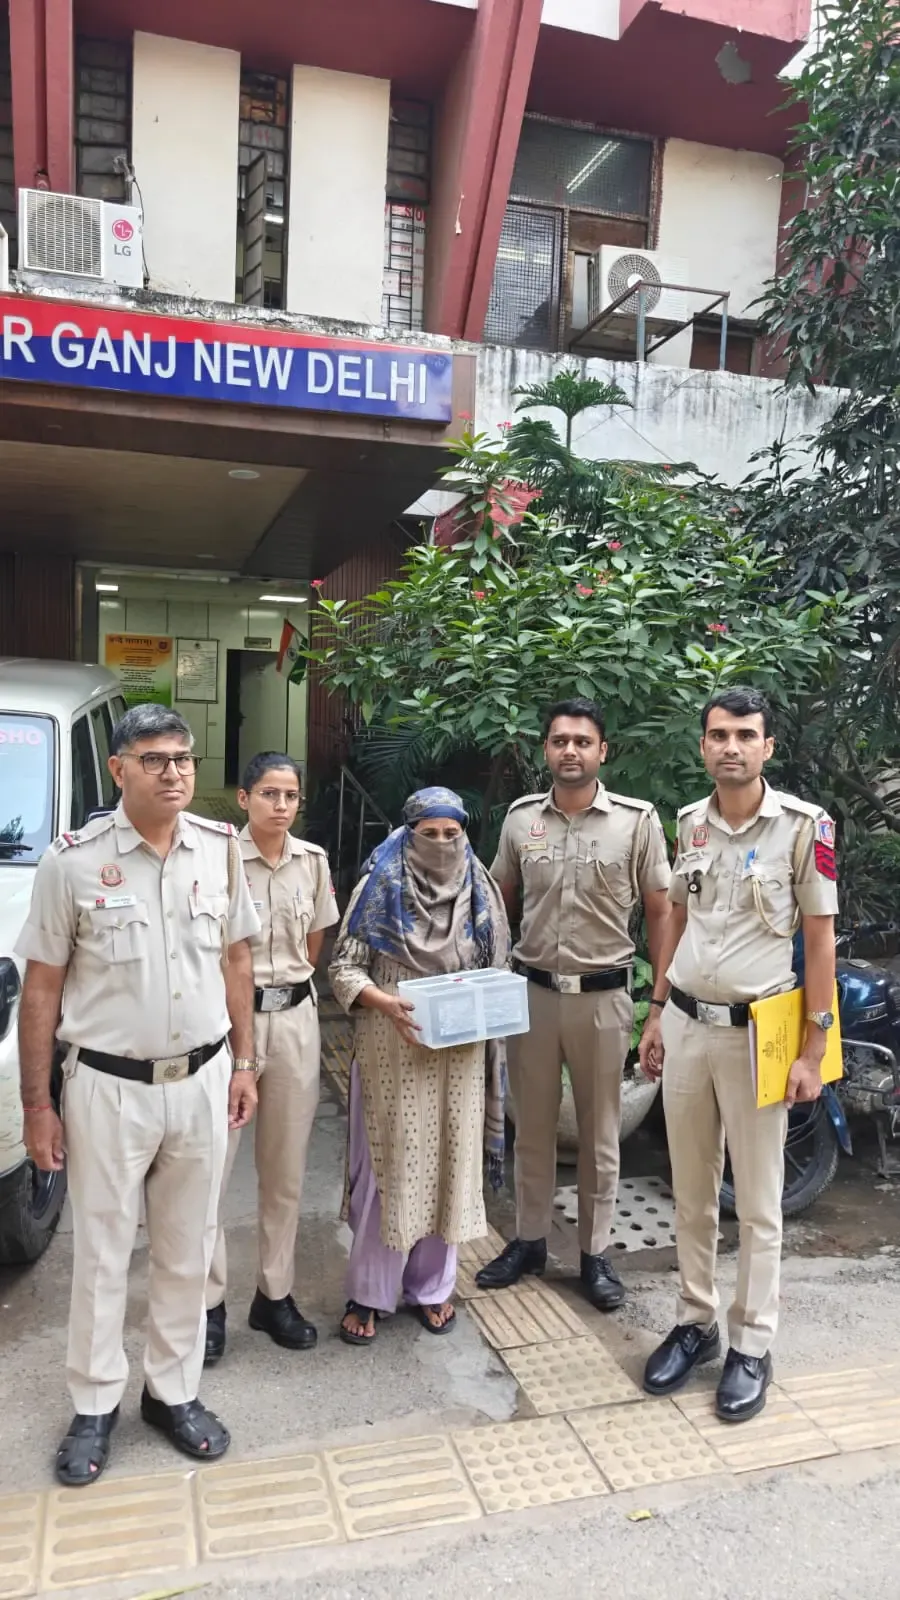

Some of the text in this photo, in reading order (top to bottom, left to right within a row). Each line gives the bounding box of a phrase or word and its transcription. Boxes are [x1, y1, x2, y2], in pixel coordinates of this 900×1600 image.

[114, 244, 131, 256] LG
[3, 315, 427, 404] R GANJ NEW DELHI
